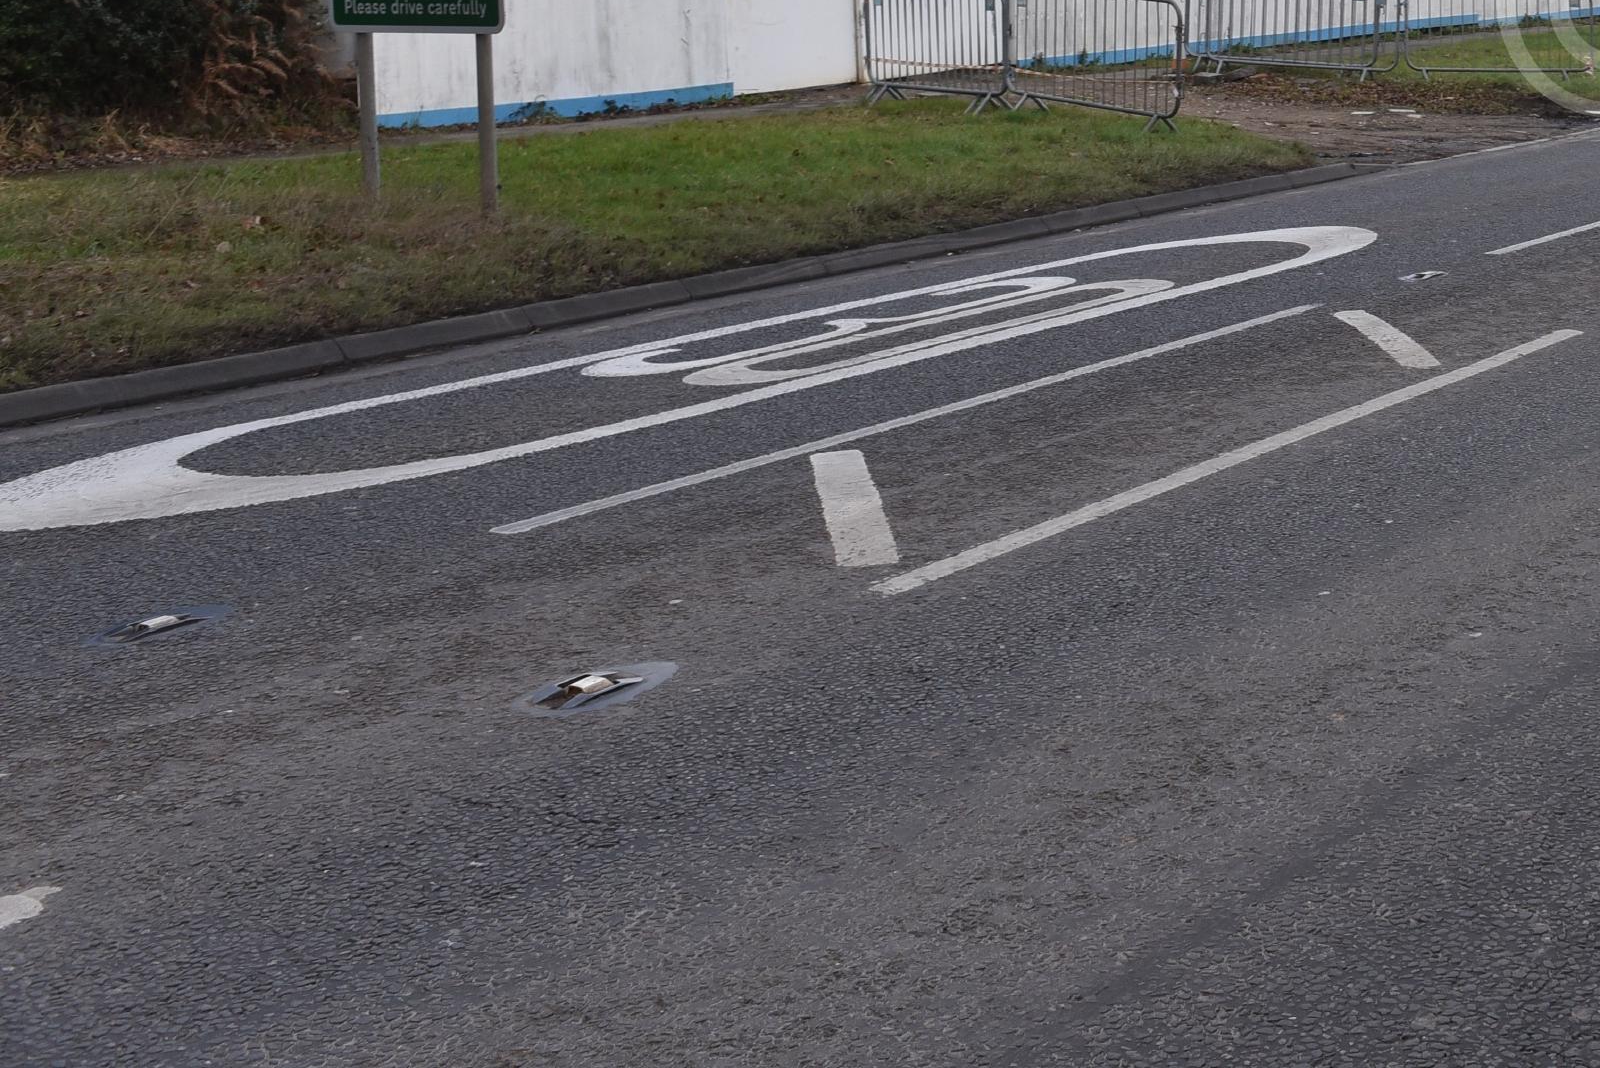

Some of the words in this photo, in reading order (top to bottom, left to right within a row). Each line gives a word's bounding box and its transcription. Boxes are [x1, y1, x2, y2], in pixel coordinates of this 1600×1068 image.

[344, 0, 387, 15] Please
[391, 0, 424, 15] drive
[427, 0, 487, 18] carefully
